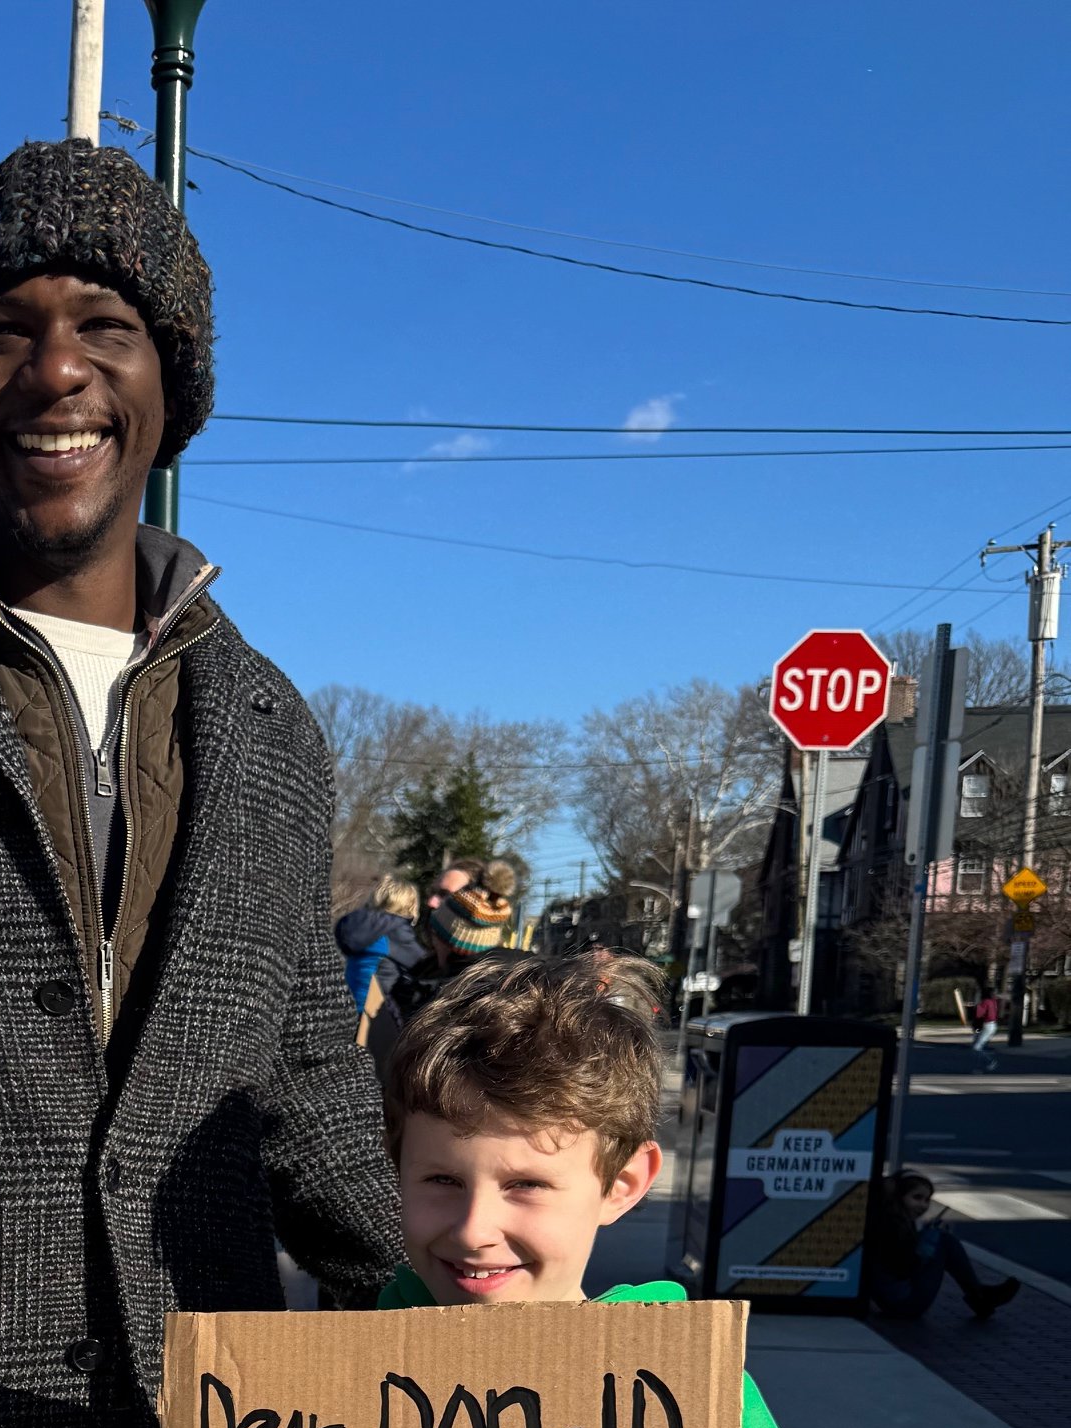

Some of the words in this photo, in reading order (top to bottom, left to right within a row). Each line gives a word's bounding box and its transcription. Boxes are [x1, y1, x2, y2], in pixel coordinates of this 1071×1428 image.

[779, 667, 882, 712] STOP
[782, 1136, 822, 1152] KEEP
[746, 1156, 856, 1173] GERMANTOWN
[773, 1176, 825, 1193] CLEAN
